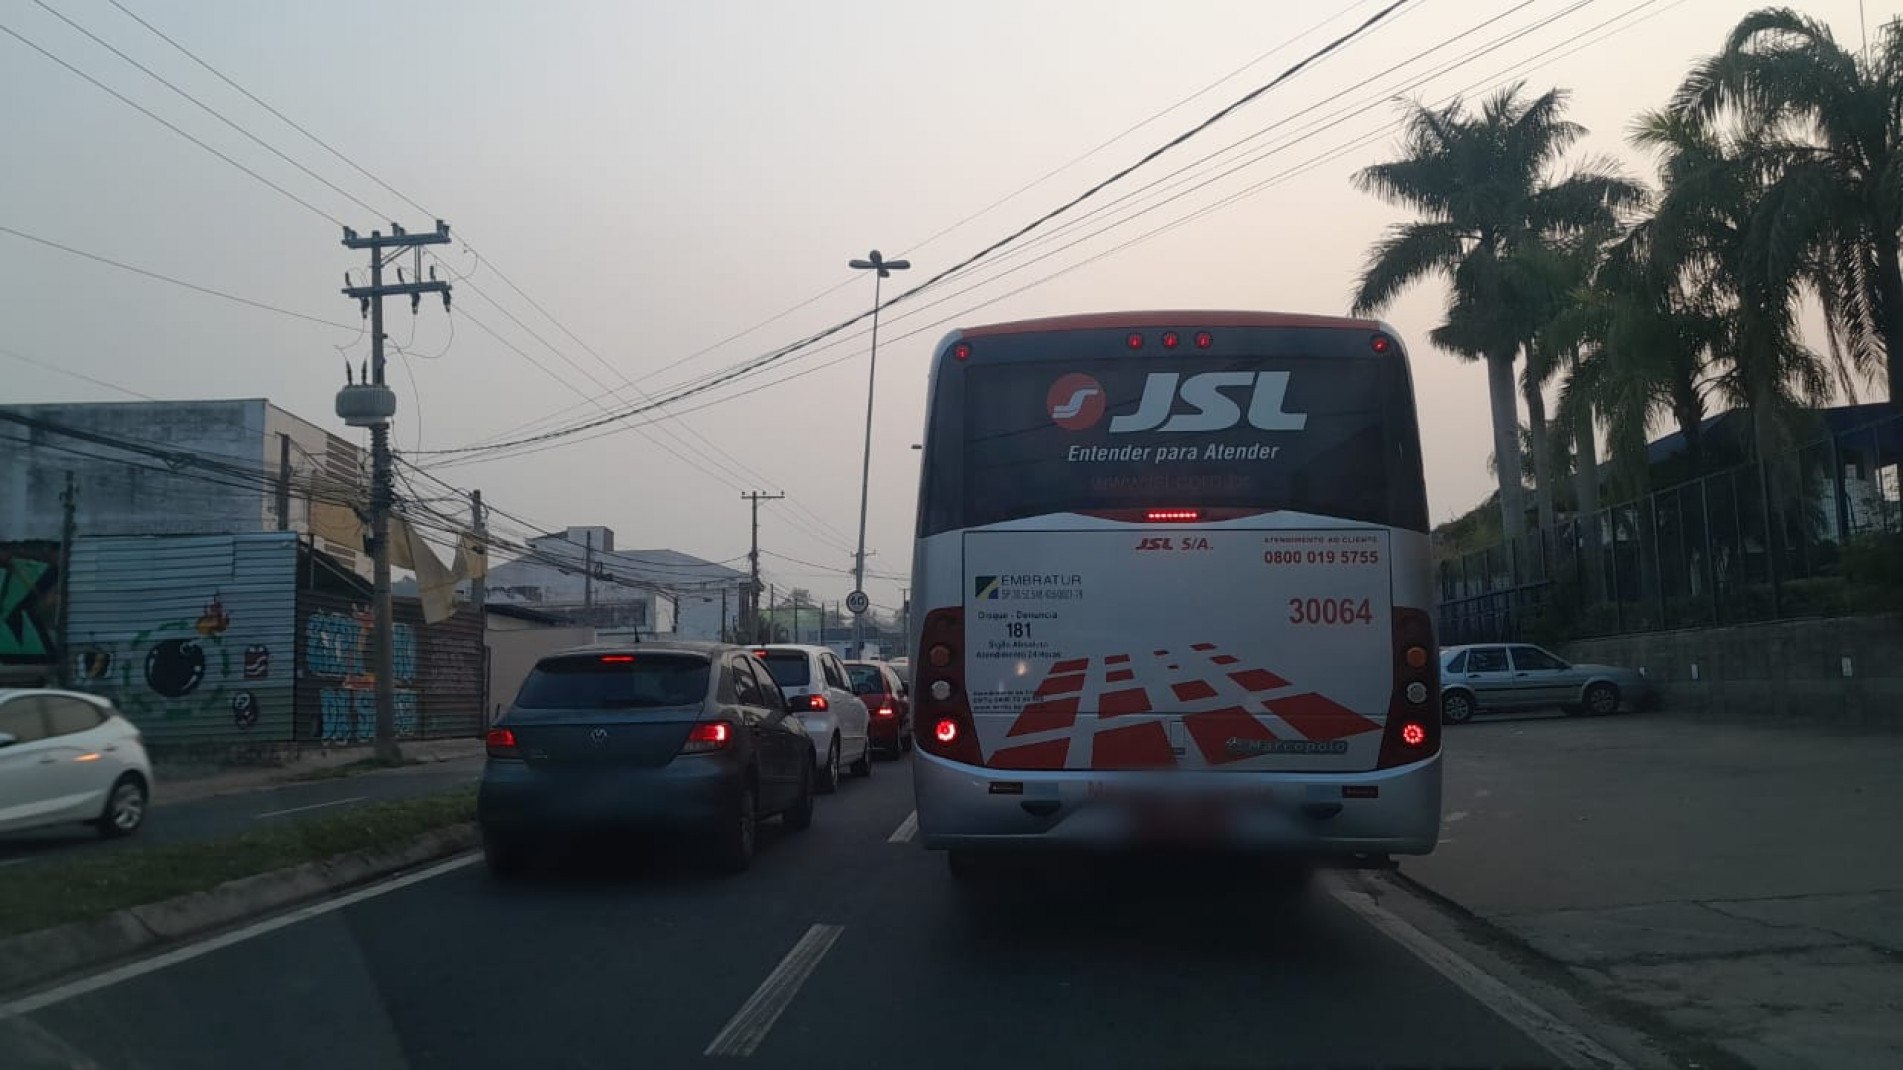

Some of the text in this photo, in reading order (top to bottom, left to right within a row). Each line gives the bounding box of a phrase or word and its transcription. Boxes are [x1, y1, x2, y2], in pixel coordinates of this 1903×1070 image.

[1109, 371, 1308, 433] JSL
[1068, 443, 1280, 464] Entender para Atender
[1136, 538, 1173, 550] JSL
[1264, 551, 1379, 563] 0800 019 5755
[1001, 574, 1082, 585] EMBRATUR
[1288, 598, 1373, 625] 30064
[1005, 622, 1032, 638] 181
[1248, 741, 1346, 753] Marcopolo
